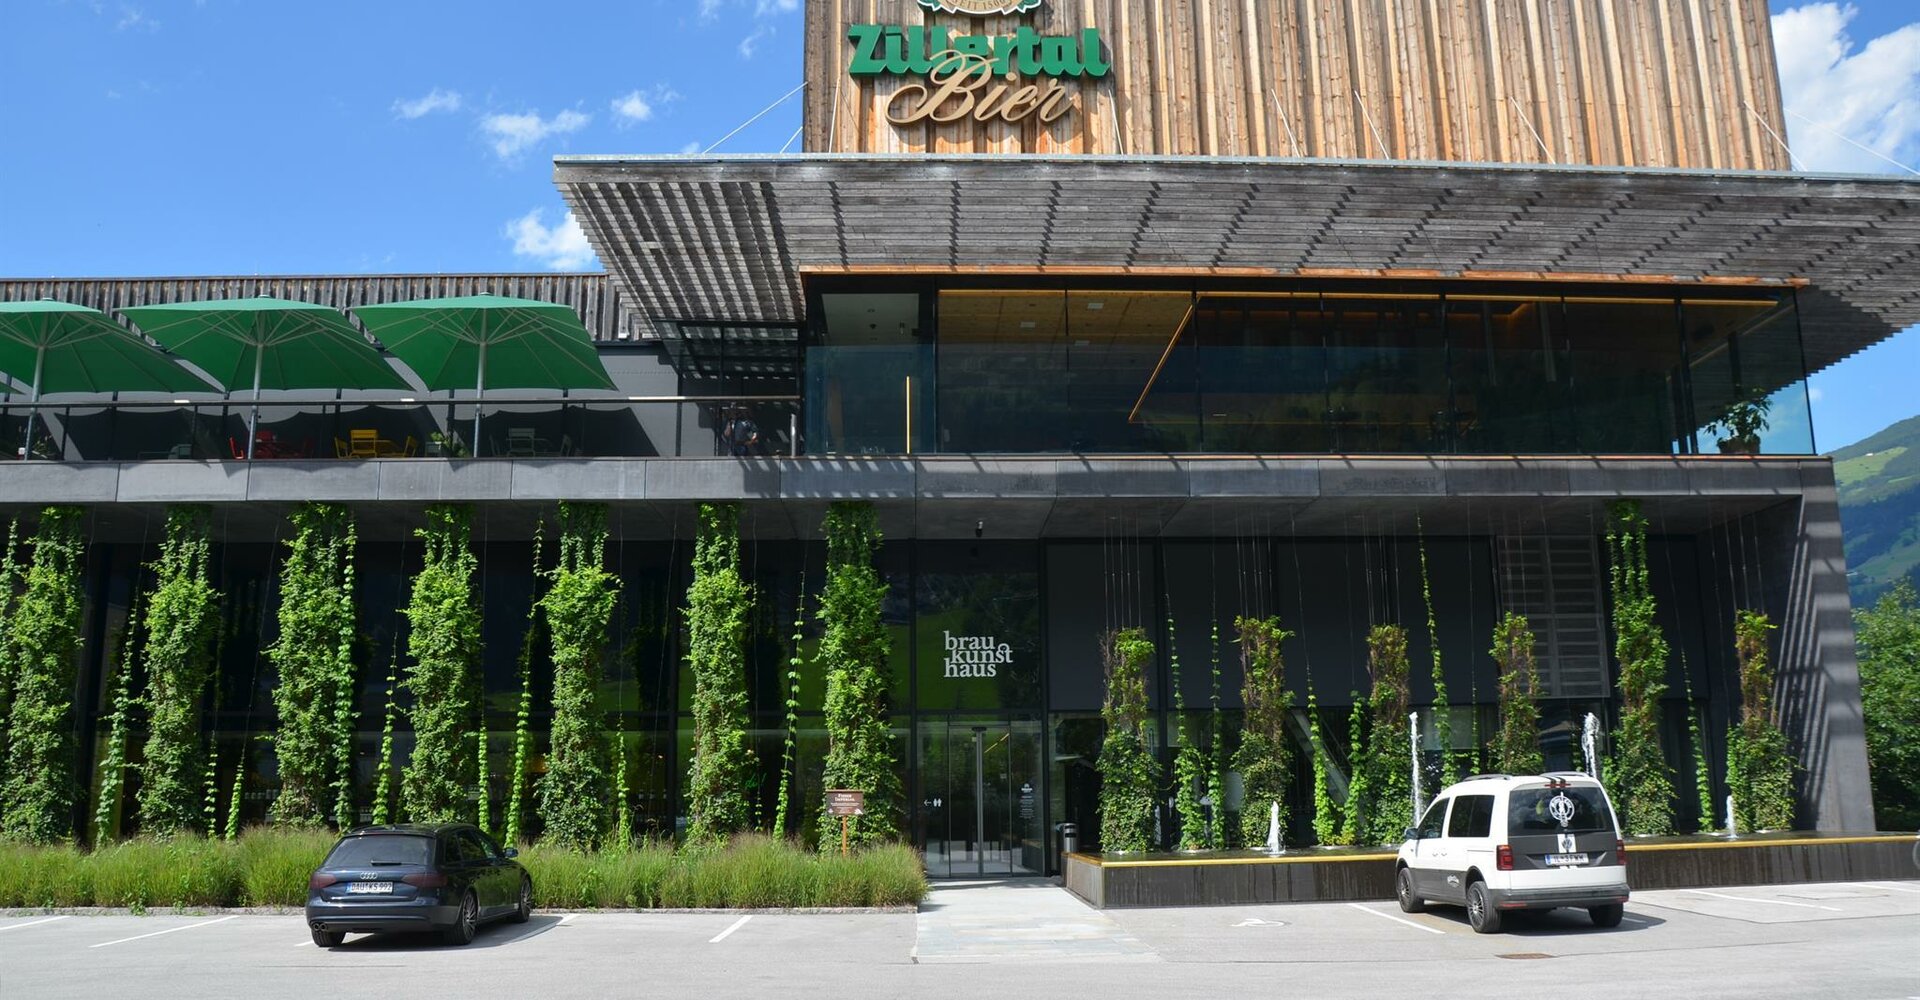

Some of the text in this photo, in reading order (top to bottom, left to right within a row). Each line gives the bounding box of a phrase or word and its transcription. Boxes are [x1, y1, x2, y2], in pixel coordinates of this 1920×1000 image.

[848, 24, 1111, 77] Zillertal
[885, 49, 1074, 123] Bier
[943, 630, 996, 650] brau
[950, 643, 1014, 664] kunst
[943, 657, 997, 678] haus
